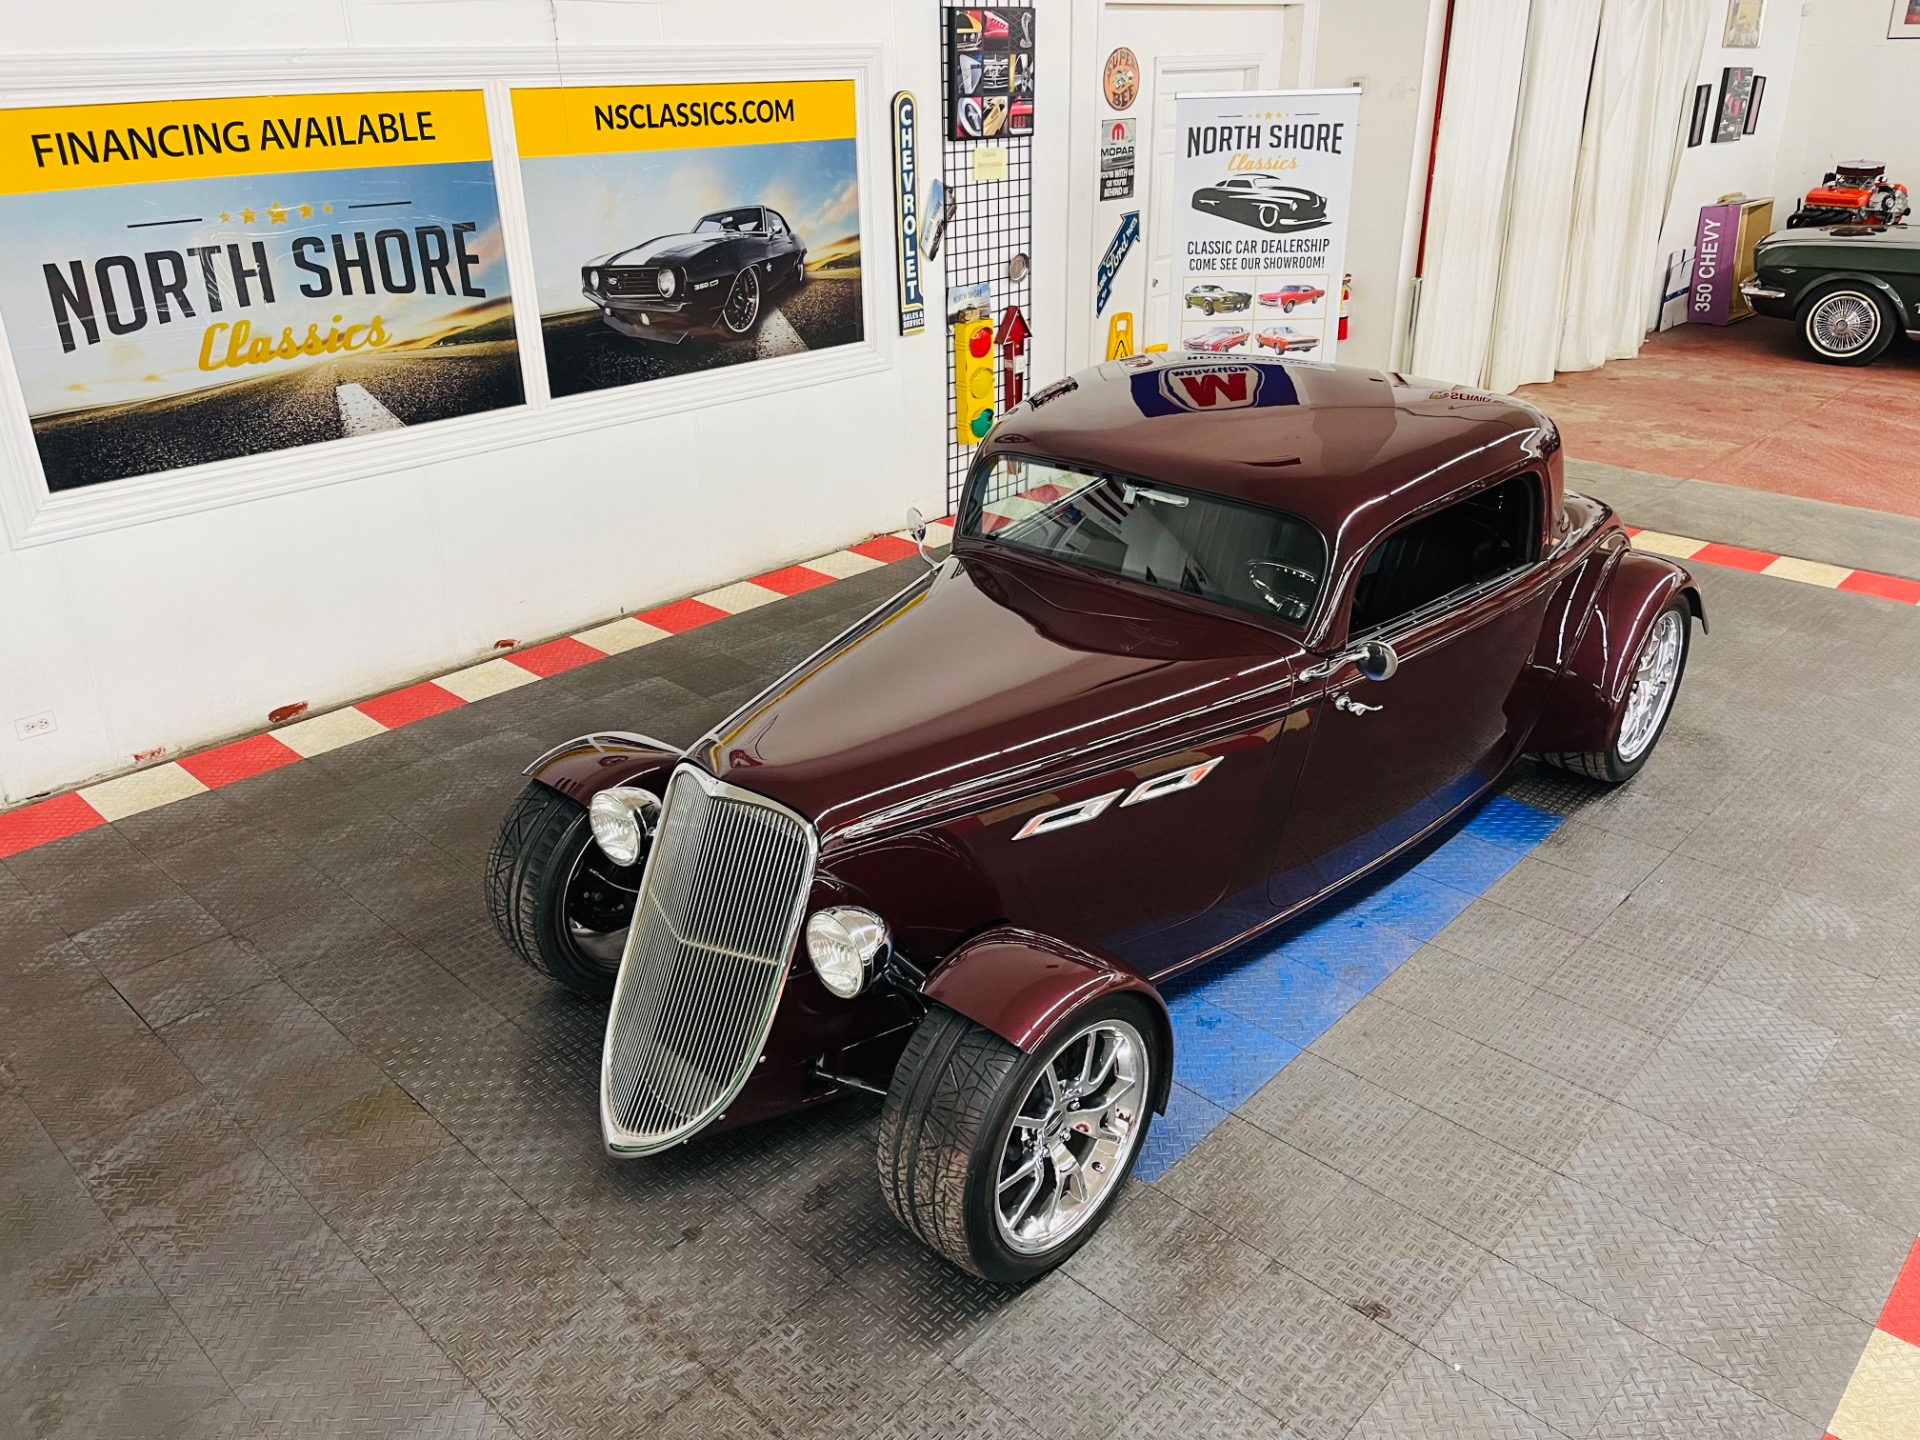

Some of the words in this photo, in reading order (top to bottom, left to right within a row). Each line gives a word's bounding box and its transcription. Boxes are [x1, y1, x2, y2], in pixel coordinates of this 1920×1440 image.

[1107, 51, 1136, 85] SUPER
[1112, 84, 1134, 107] BEE
[594, 99, 795, 131] NSCLASSICS.COM
[31, 120, 250, 167] FINANCING
[259, 111, 436, 151] AVAILABLE
[1101, 146, 1134, 157] MOPAR
[1187, 125, 1261, 158] NORTH
[1269, 123, 1344, 155] SHORE
[1114, 168, 1128, 179] WITH
[1227, 154, 1299, 171] Classics
[900, 104, 918, 300] CHEVROLET
[1104, 187, 1123, 198] BEHIND
[1106, 234, 1129, 277] Ford
[1187, 240, 1232, 255] CLASSIC
[1235, 239, 1257, 254] CAR
[1261, 238, 1330, 254] DEALERSHIP
[1698, 218, 1721, 279] CHEVY
[1189, 258, 1217, 271] COME
[1220, 257, 1237, 270] SEE
[1241, 257, 1261, 270] OUR
[1263, 256, 1325, 270] SHOWROOM!
[42, 241, 276, 353] NORTH
[292, 222, 487, 299] SHORE
[1694, 283, 1713, 312] 350
[903, 312, 919, 321] SALES
[197, 314, 393, 372] Classics
